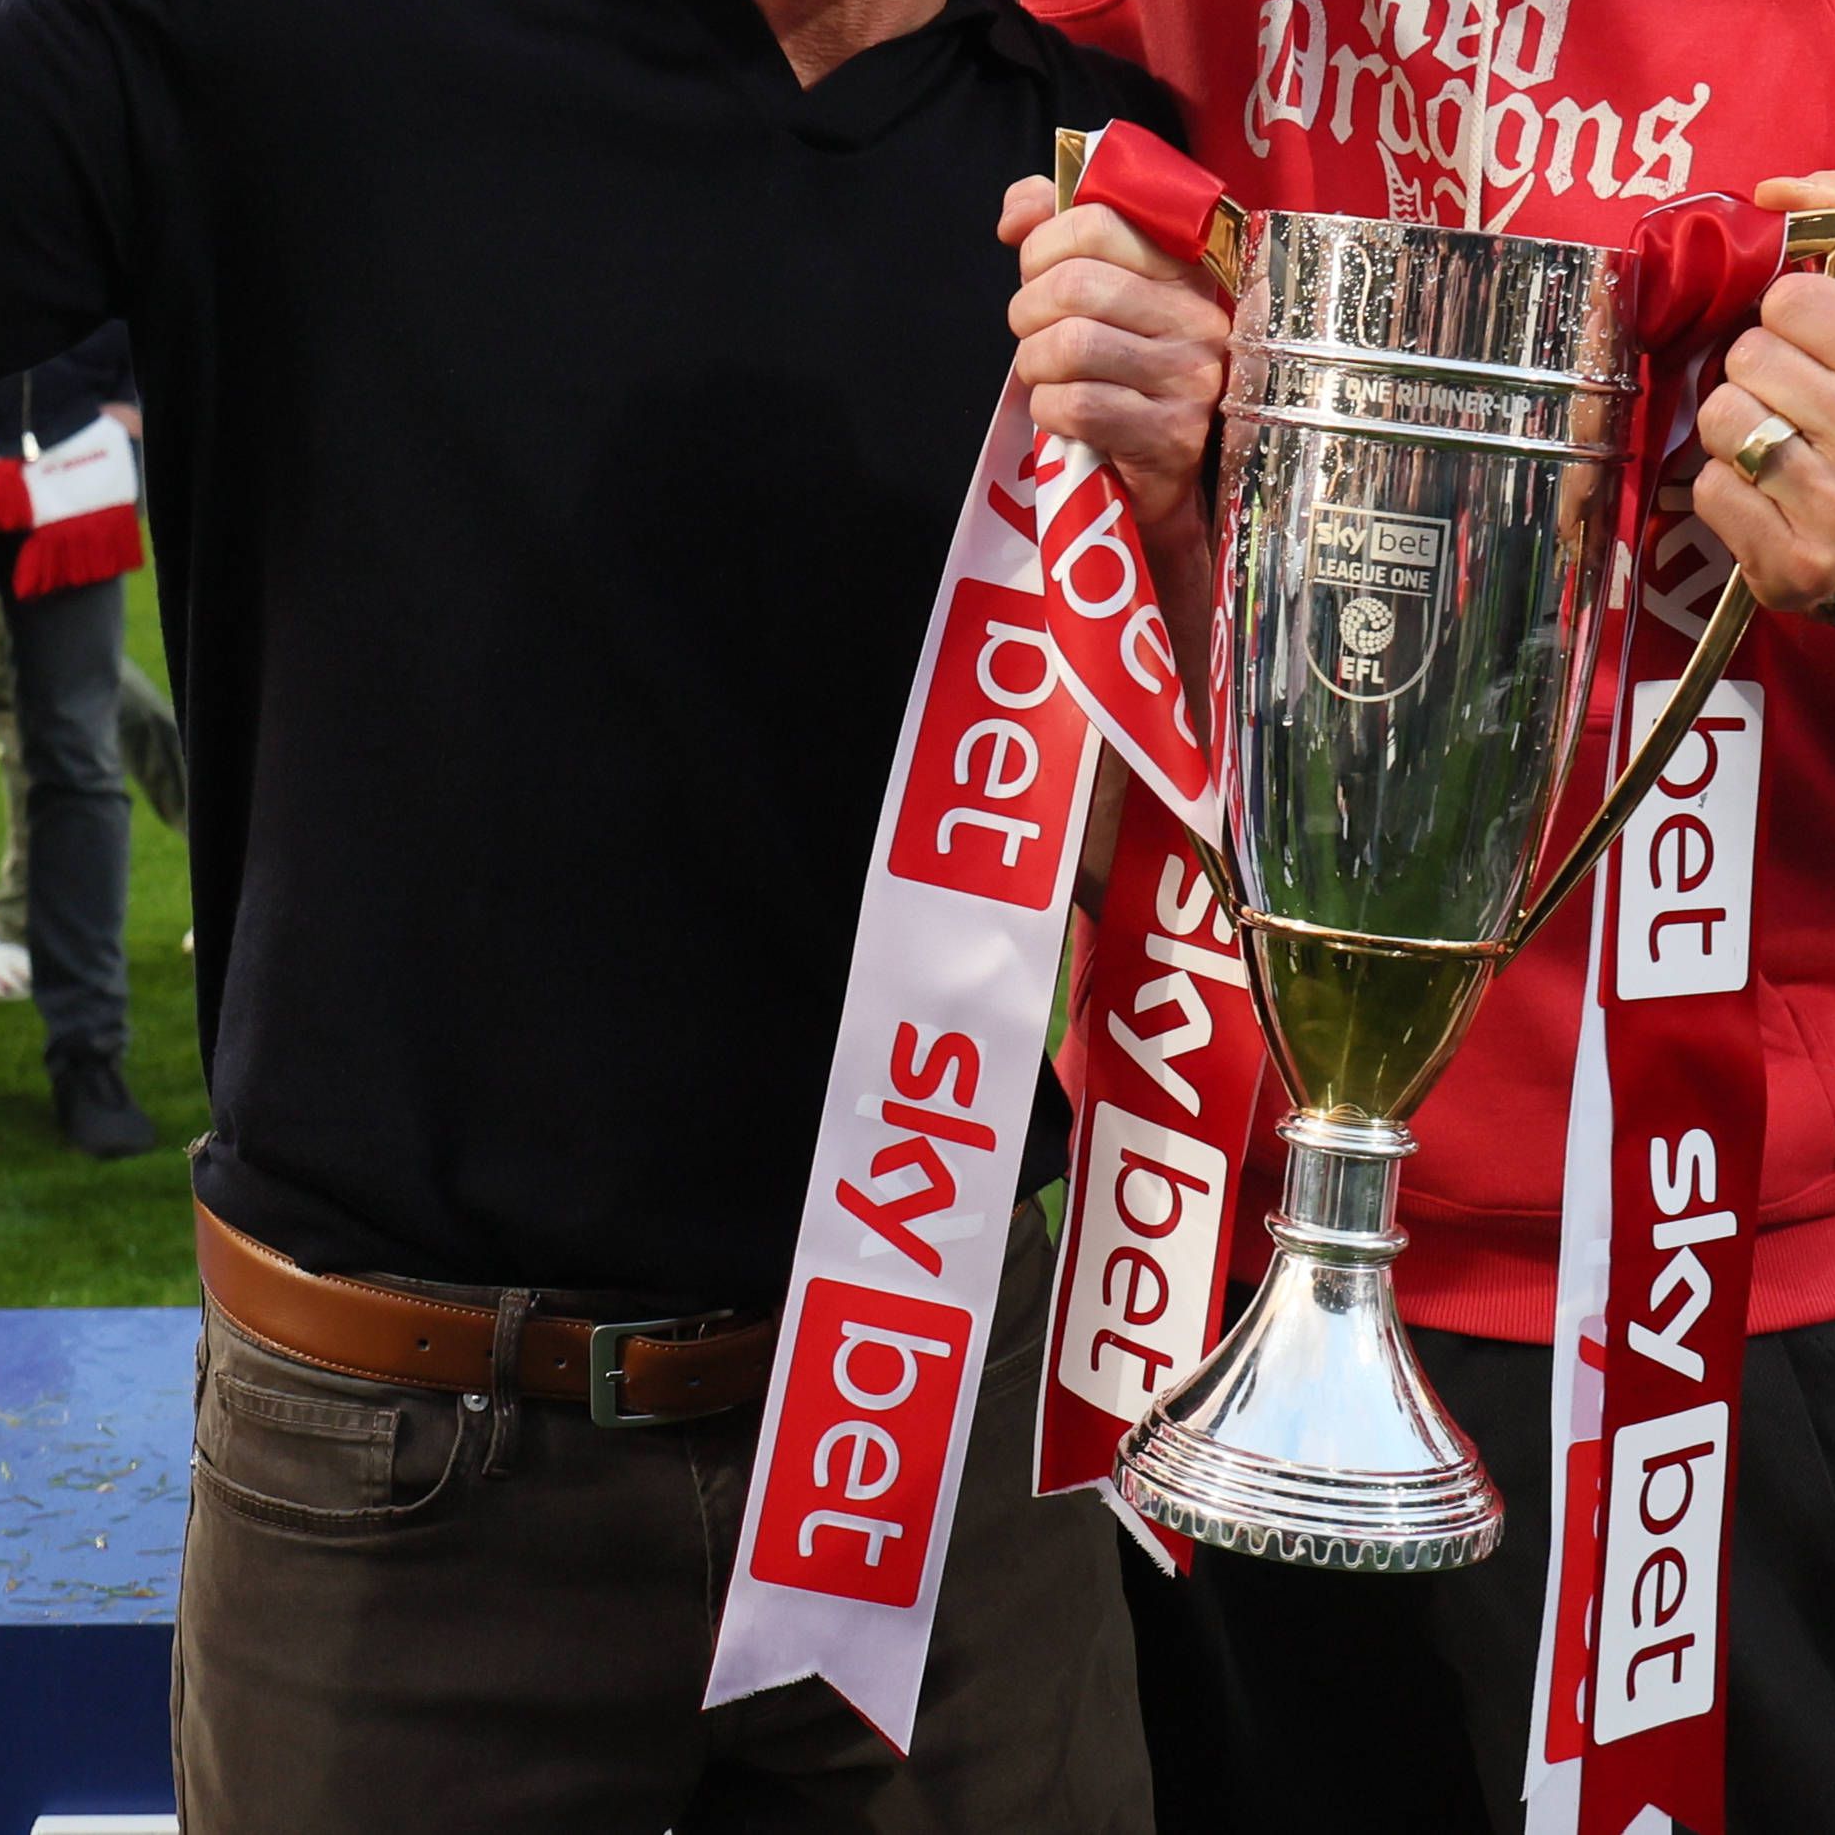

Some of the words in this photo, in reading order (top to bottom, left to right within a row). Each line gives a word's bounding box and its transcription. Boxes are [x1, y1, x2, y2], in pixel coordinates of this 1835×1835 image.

[1345, 376, 1392, 403] ONE
[1396, 383, 1532, 419] RUNNER-UP
[1315, 518, 1367, 555] sky
[1378, 526, 1431, 557] bet
[1317, 556, 1386, 584] LEAGUE
[1390, 567, 1431, 590] ONE
[936, 619, 1060, 868] bet
[1340, 655, 1385, 685] EFL
[1648, 716, 1746, 963] bet
[1107, 853, 1249, 1118] sky
[835, 1021, 997, 1278] sky
[1090, 1147, 1210, 1393] bet
[1626, 1127, 1738, 1383] sky
[797, 1319, 953, 1568] bet
[1625, 1439, 1715, 1703] bet
